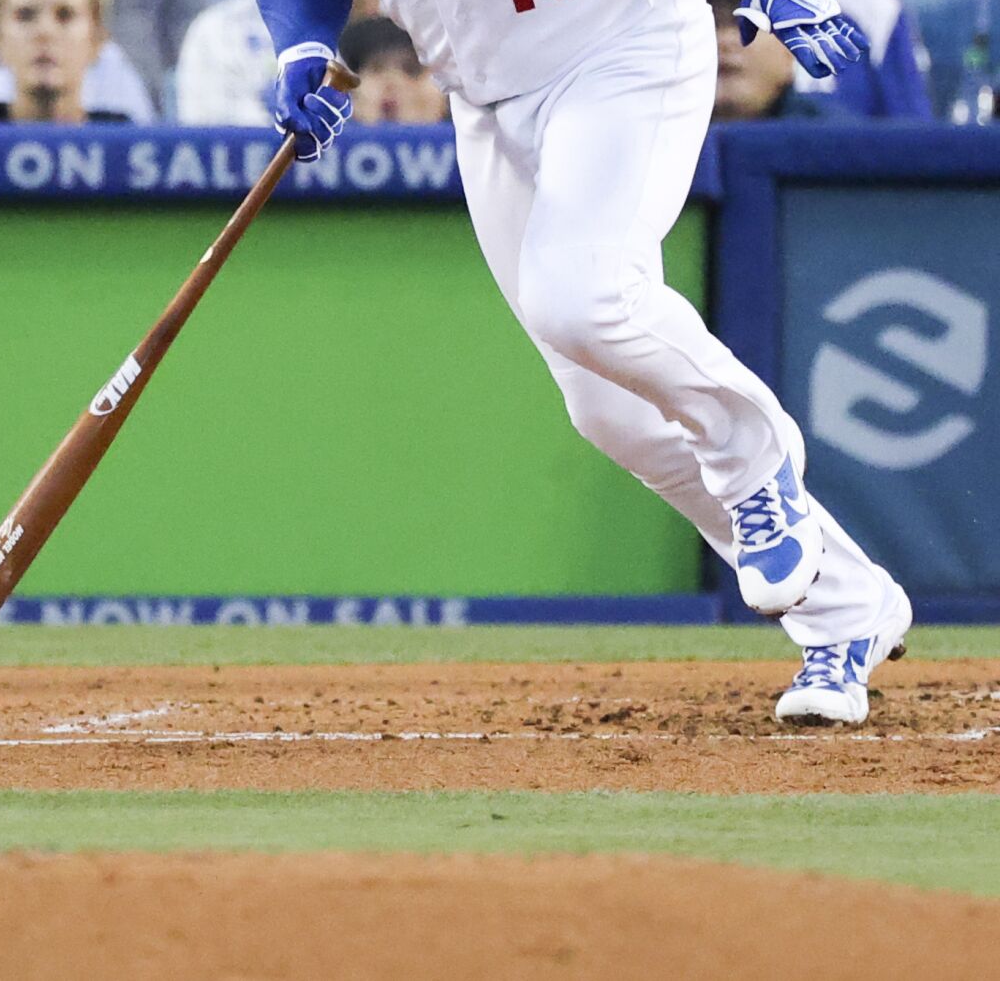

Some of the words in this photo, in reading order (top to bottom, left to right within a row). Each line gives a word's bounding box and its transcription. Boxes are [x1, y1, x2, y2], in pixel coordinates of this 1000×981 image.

[5, 141, 106, 190] ON
[127, 141, 272, 190] SALE
[294, 141, 453, 190] NOW
